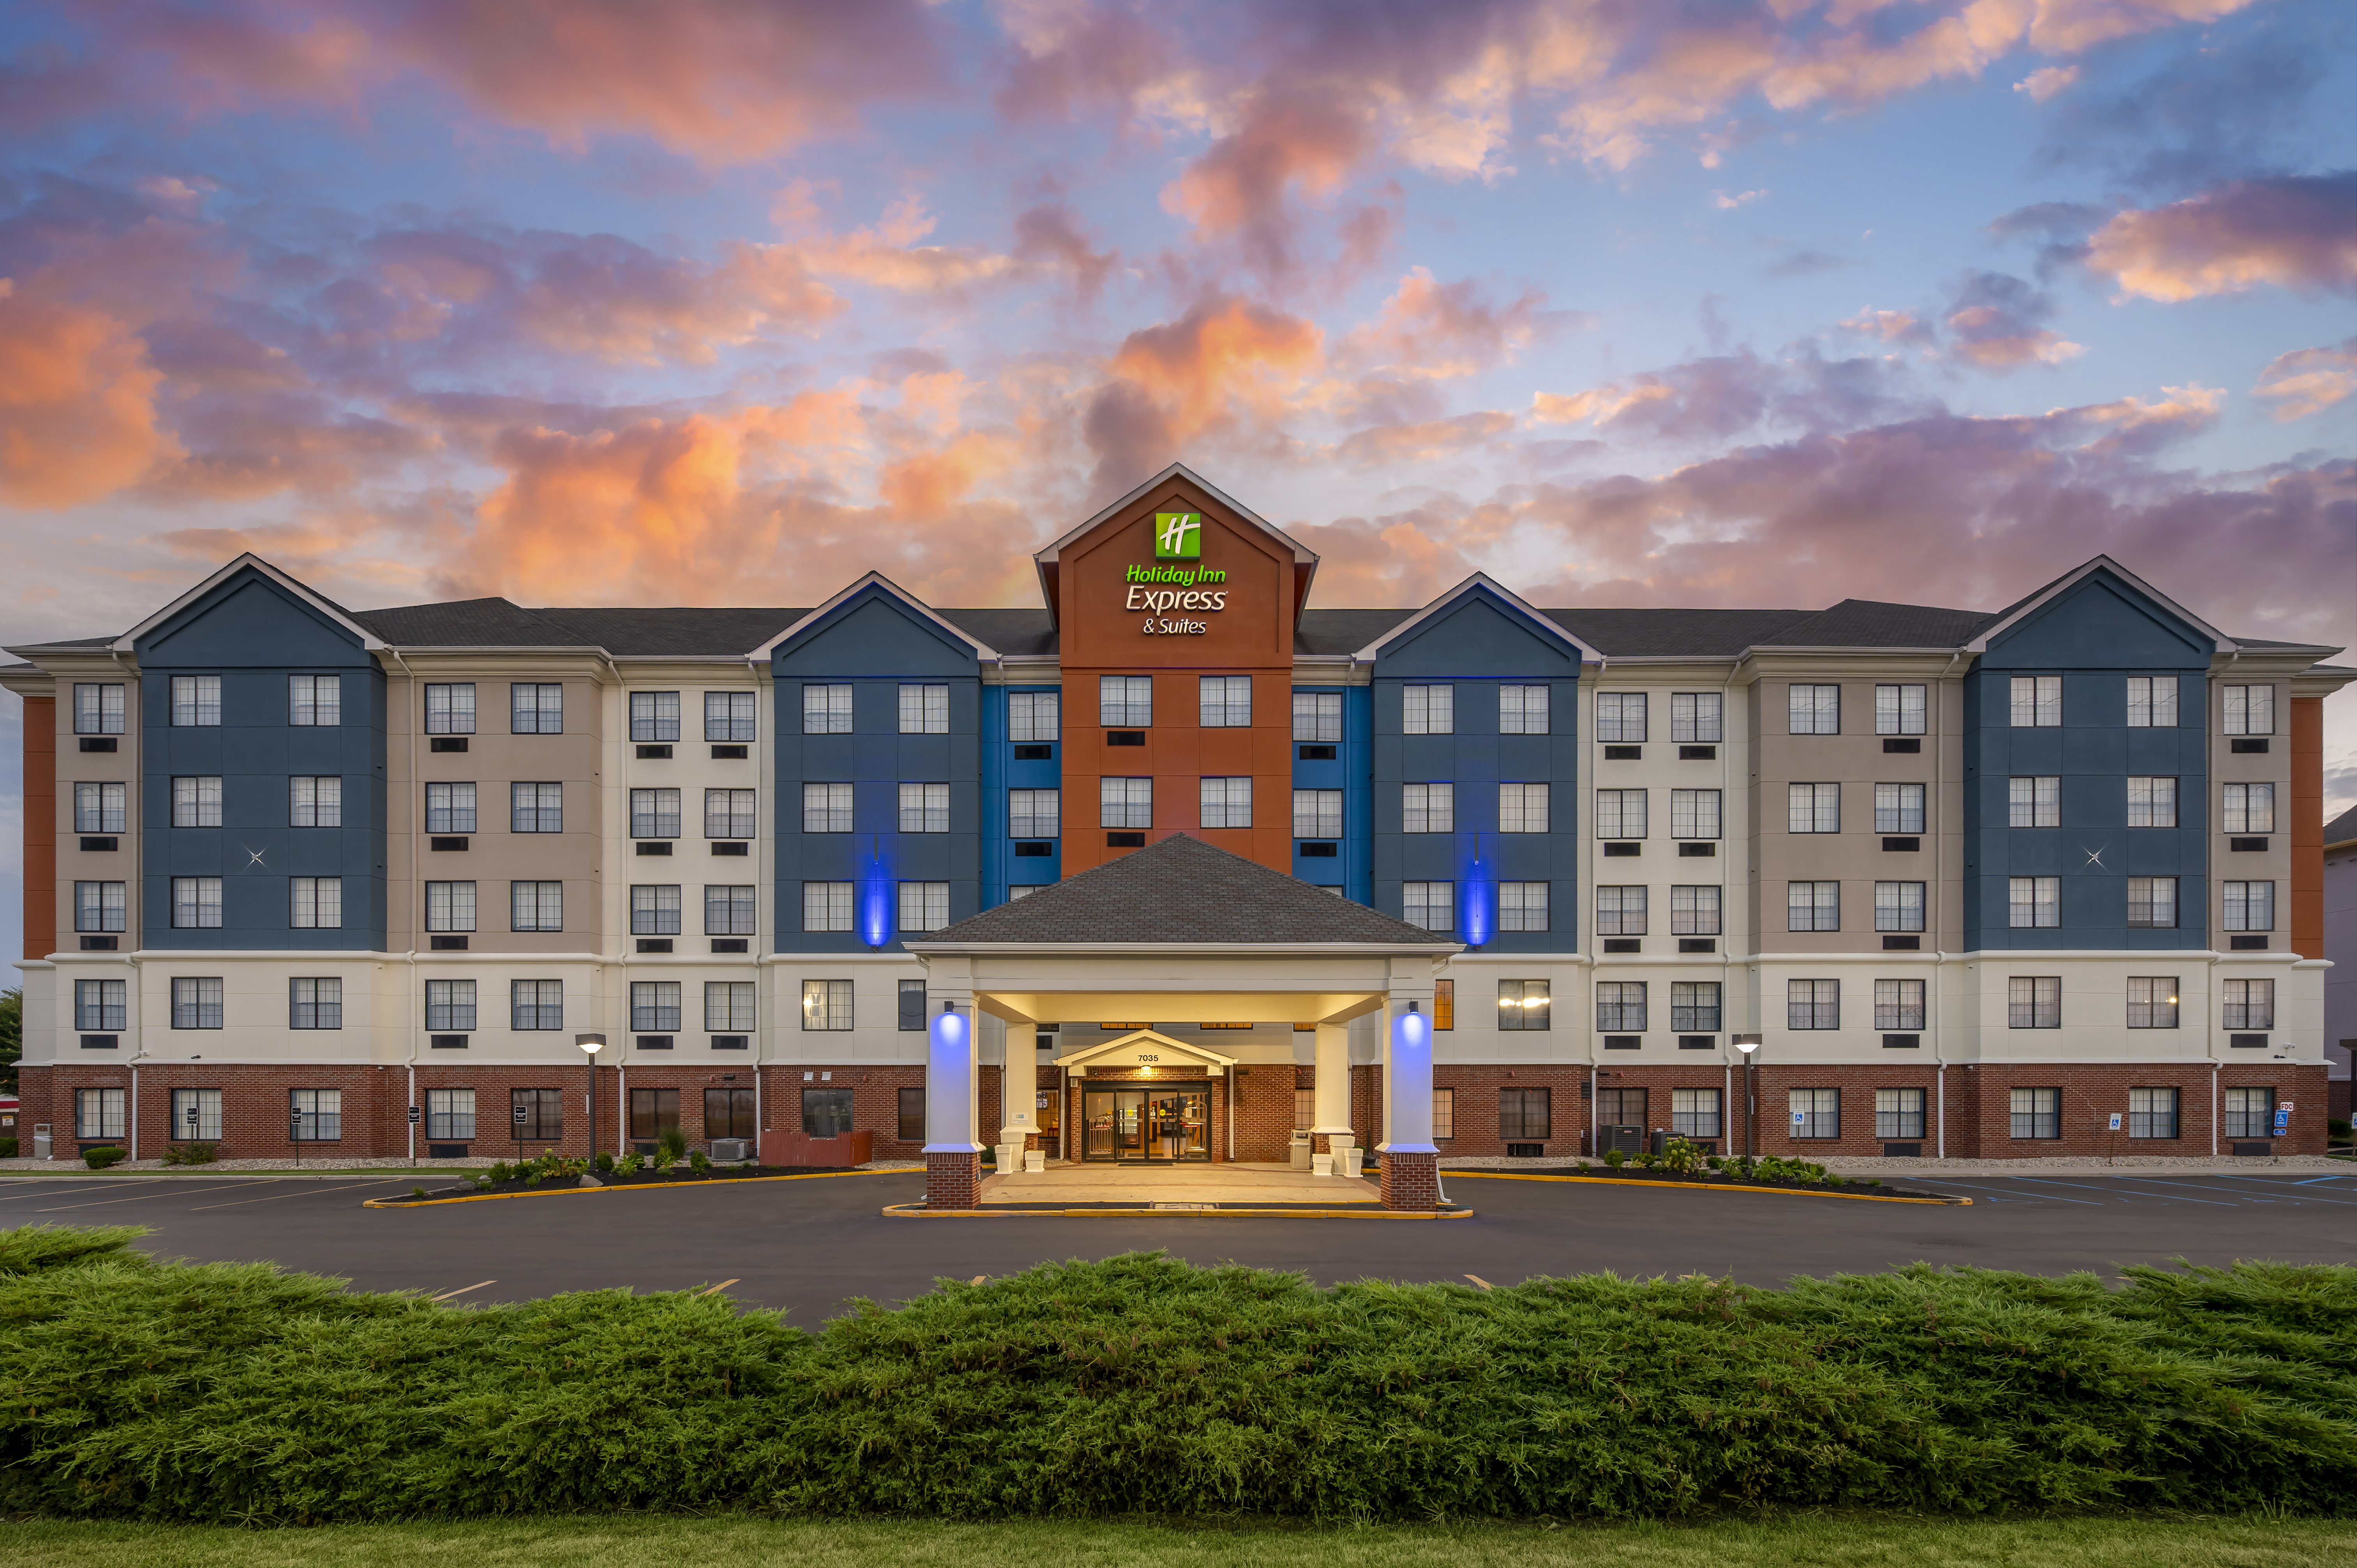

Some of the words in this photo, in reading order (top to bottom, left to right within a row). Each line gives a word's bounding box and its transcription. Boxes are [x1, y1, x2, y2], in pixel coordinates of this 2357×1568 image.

[1125, 564, 1195, 587] Holiday
[1198, 565, 1226, 583] Inn
[1125, 585, 1226, 617] Express
[1143, 618, 1154, 634] &
[1158, 618, 1207, 634] Suites
